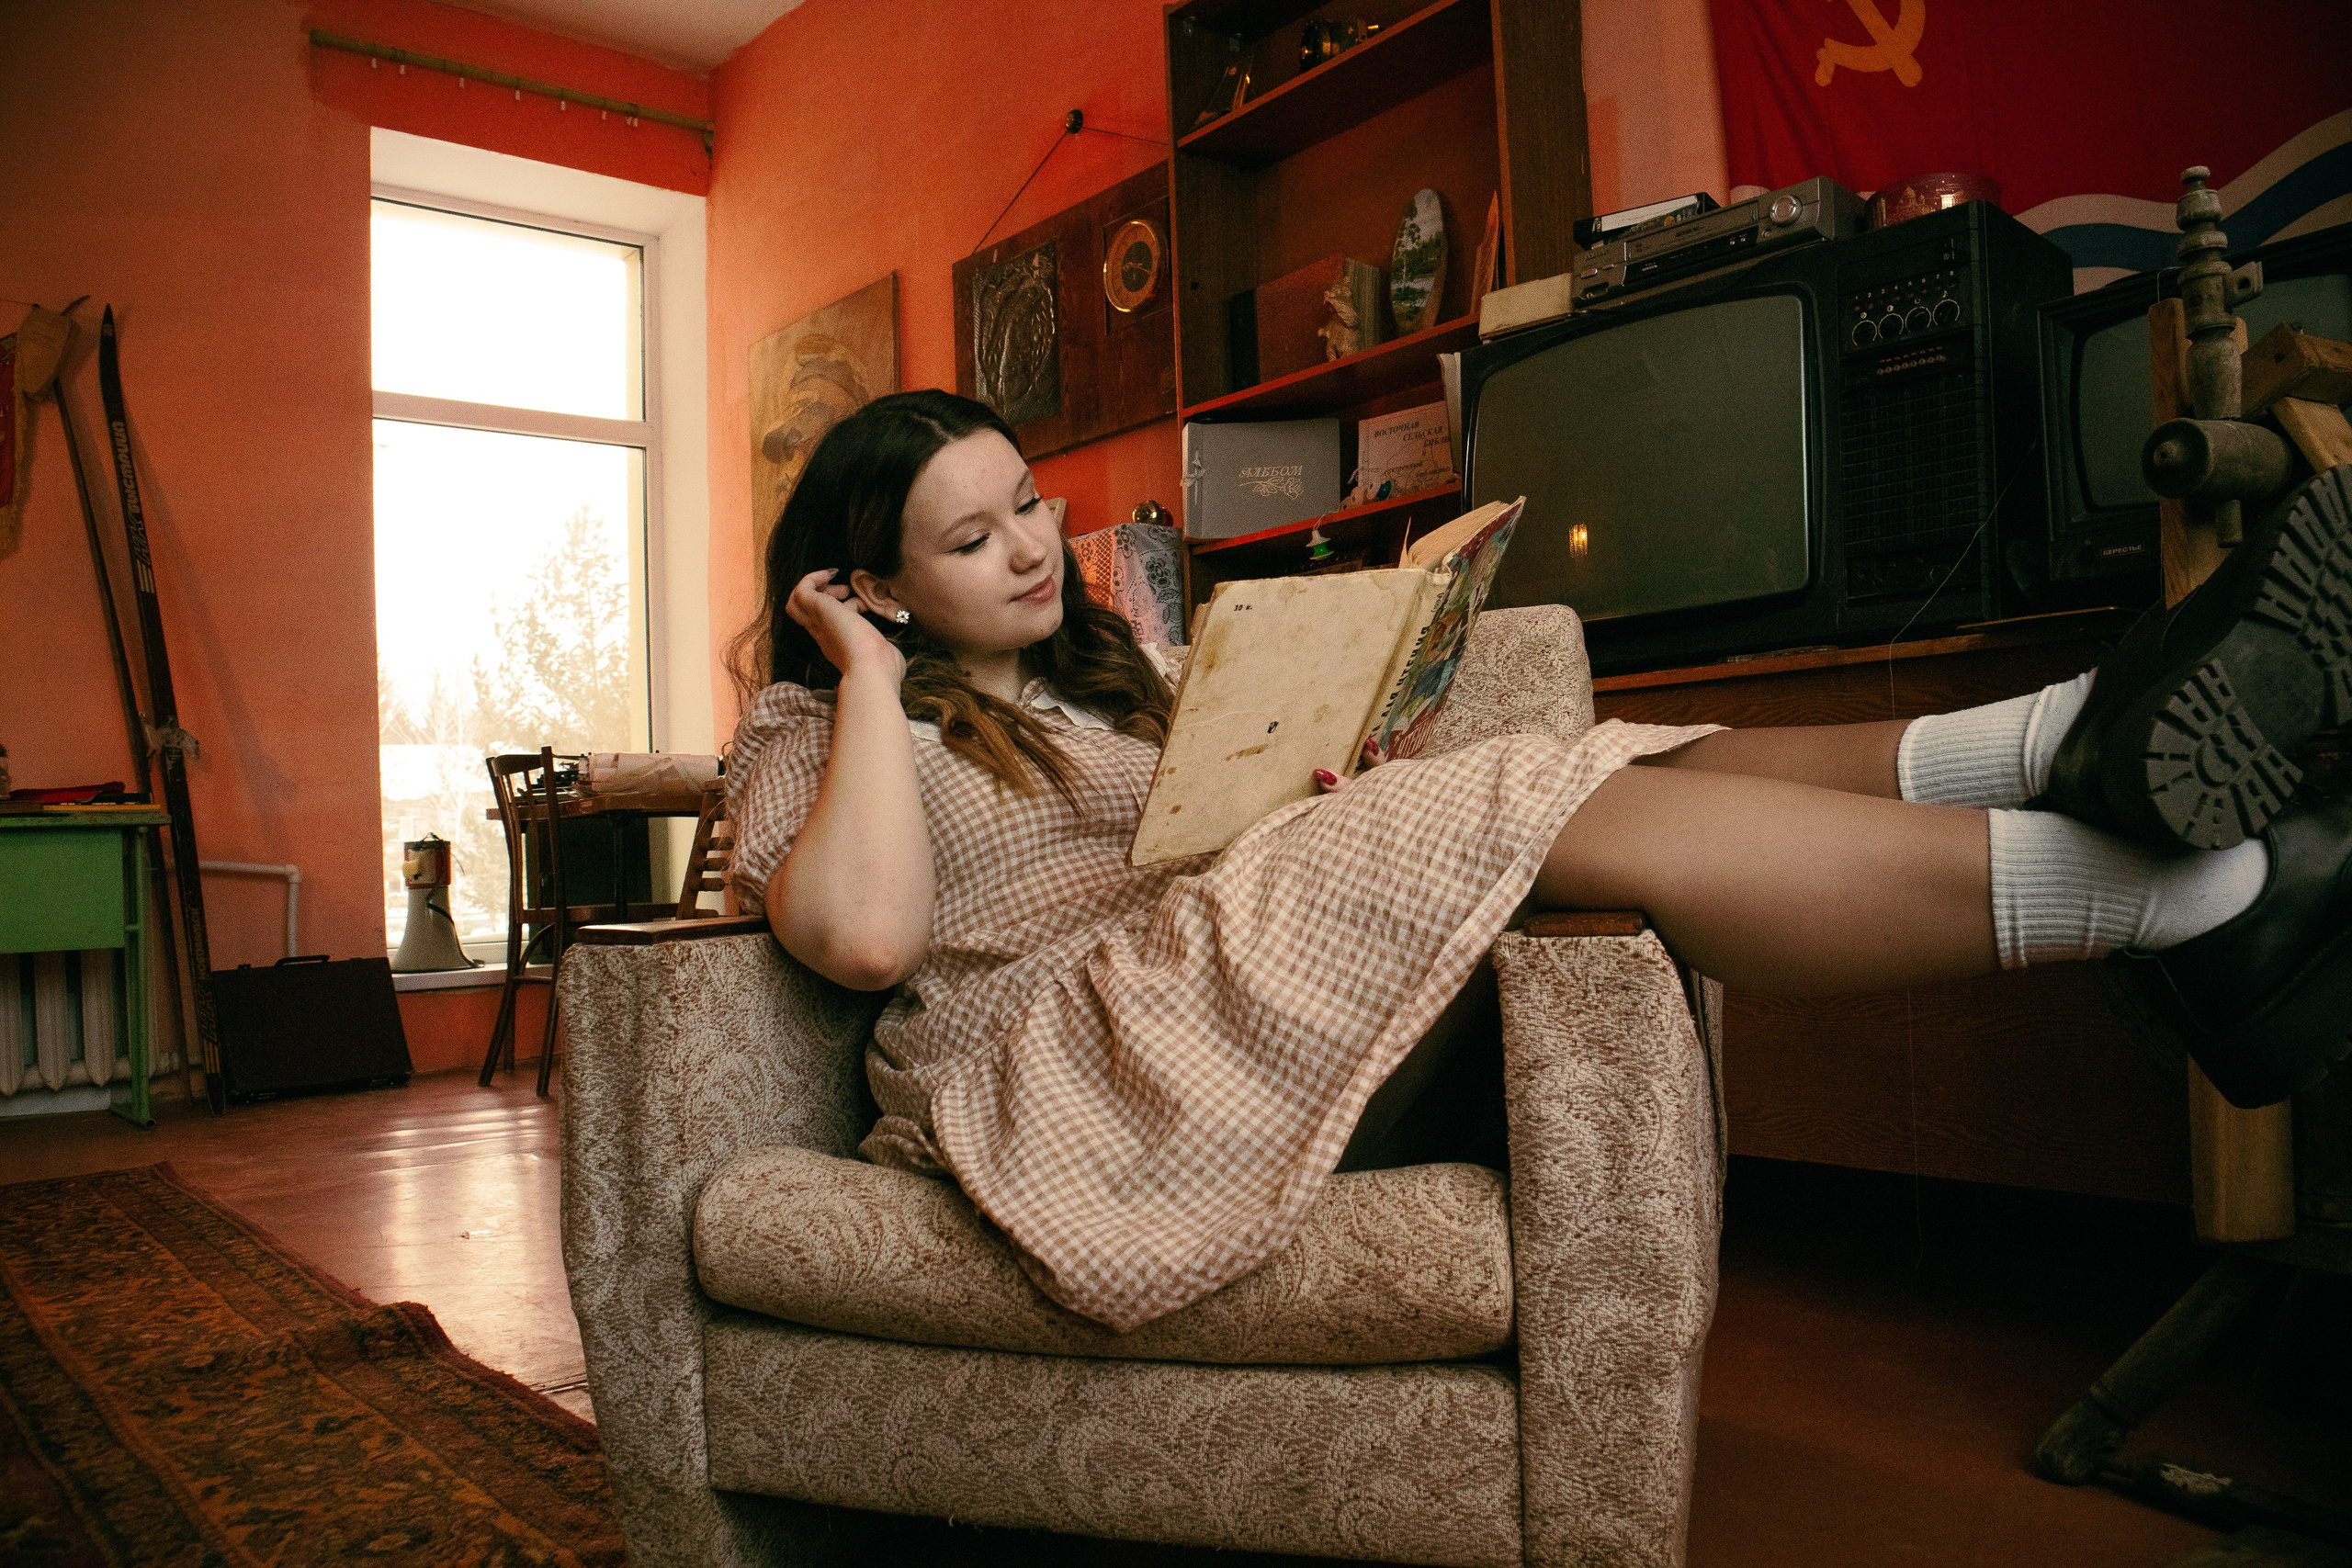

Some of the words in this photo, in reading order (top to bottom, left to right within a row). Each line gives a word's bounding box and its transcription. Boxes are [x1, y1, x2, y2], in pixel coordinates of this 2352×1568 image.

[1374, 421, 1419, 437] ВОСТОЧНАЯ
[1402, 425, 1443, 442] СЕЛЬСКАЯ
[1238, 465, 1304, 479] АЛЬБОМ
[2103, 545, 2142, 556] БЕРЕСТЬЕ
